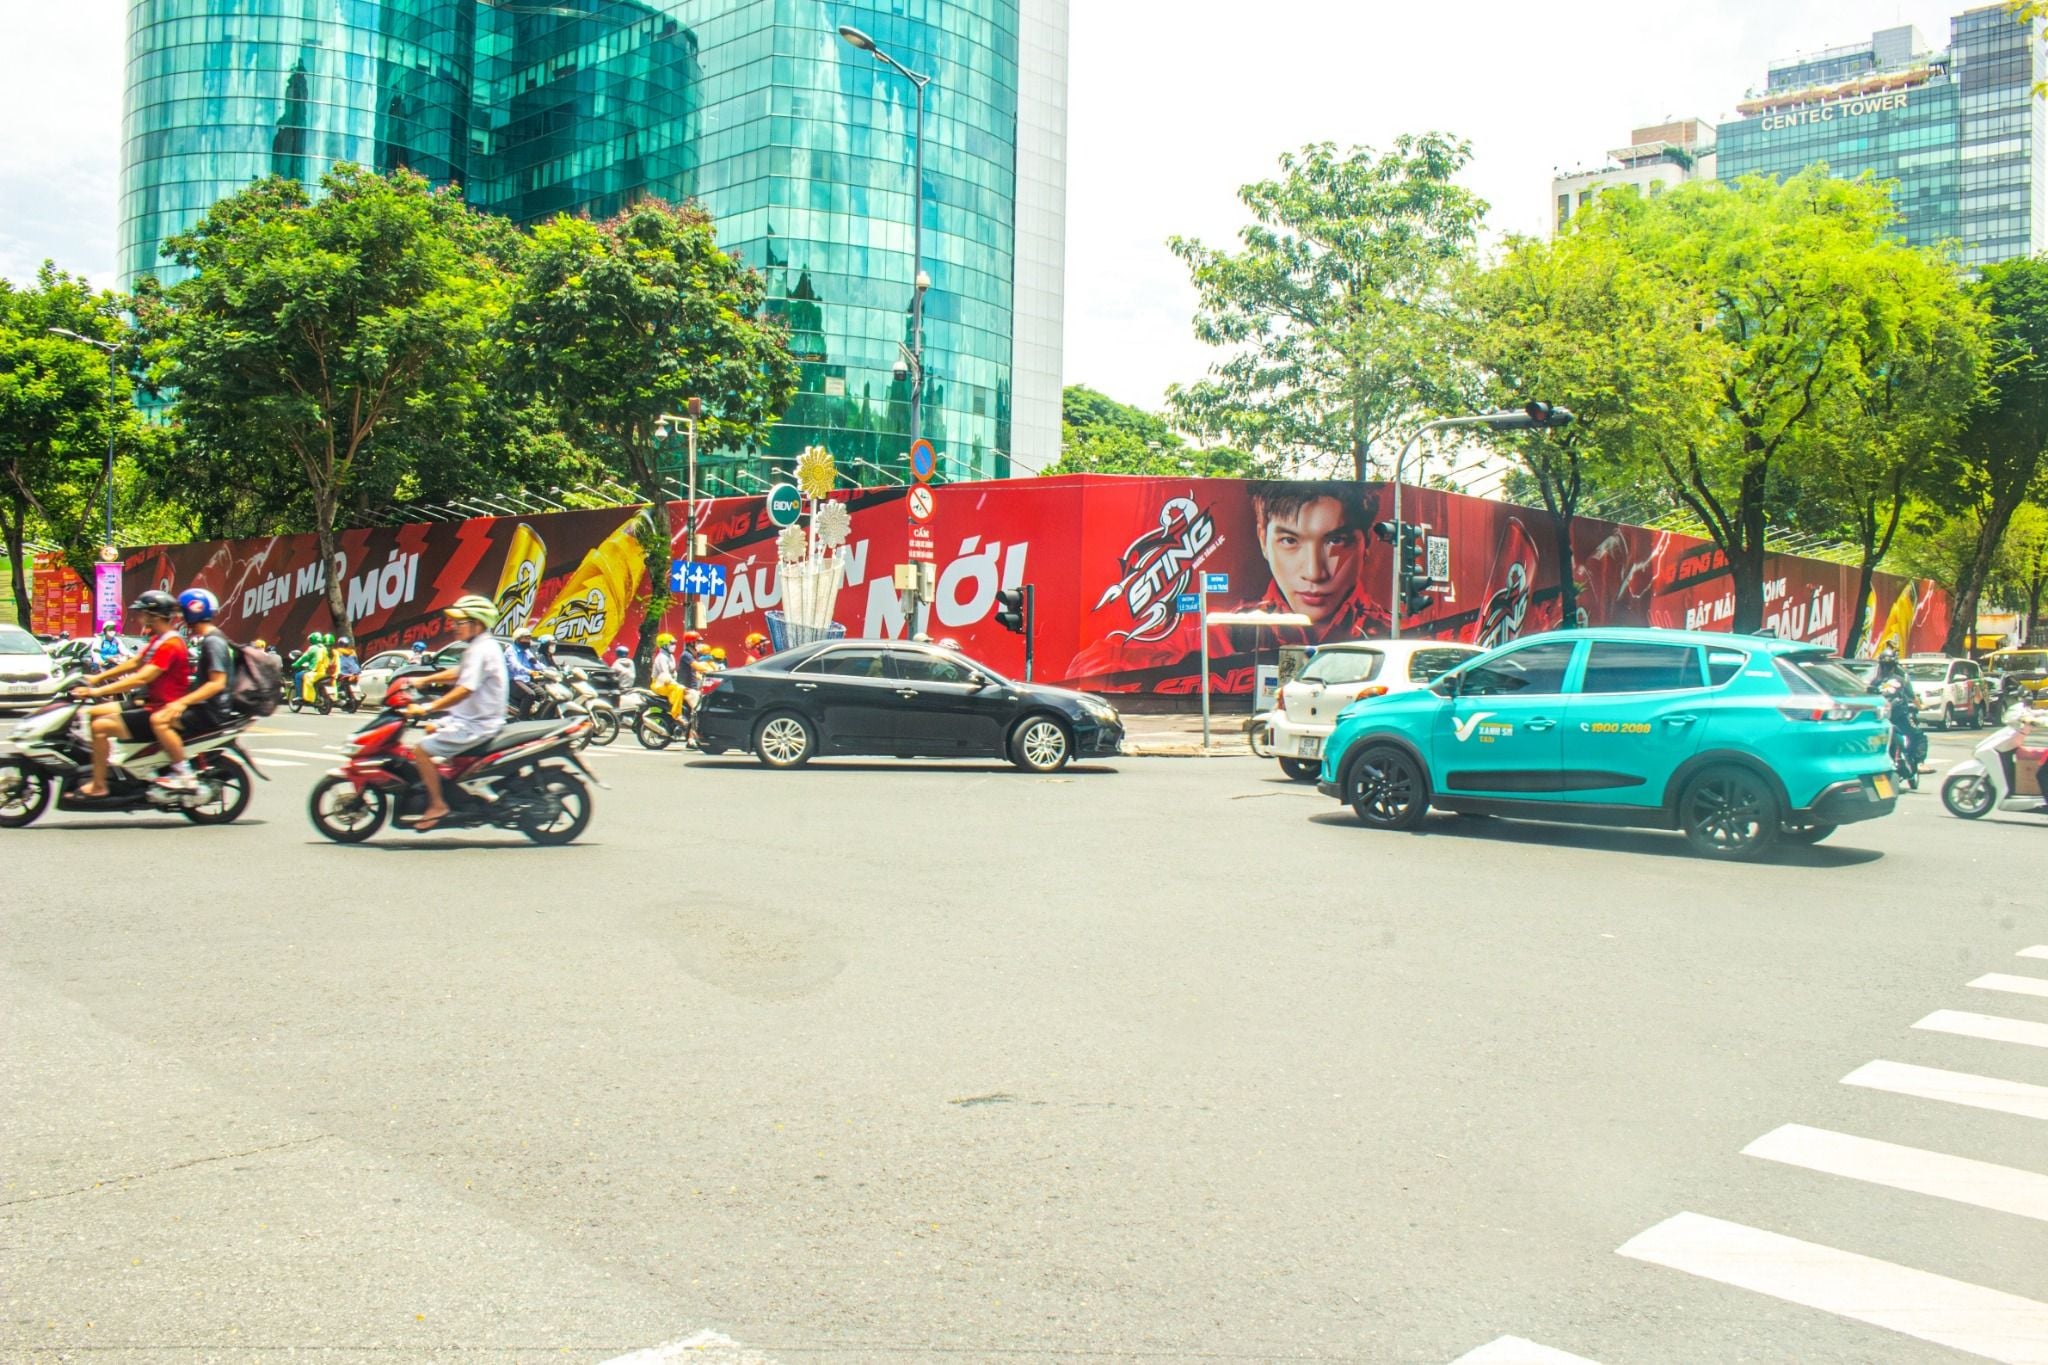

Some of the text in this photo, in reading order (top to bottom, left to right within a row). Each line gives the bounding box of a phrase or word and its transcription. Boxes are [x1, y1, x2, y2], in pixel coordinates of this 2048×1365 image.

[1762, 94, 1908, 131] CENTEC TOWER
[773, 500, 793, 511] BIDV
[1129, 515, 1213, 614] STING
[242, 571, 291, 619] DIỆN
[346, 549, 419, 622] MỚI
[554, 611, 607, 640] STING
[1686, 600, 1712, 632] BẬT
[1807, 585, 1835, 635] ẤN
[1591, 723, 1619, 732] 1900
